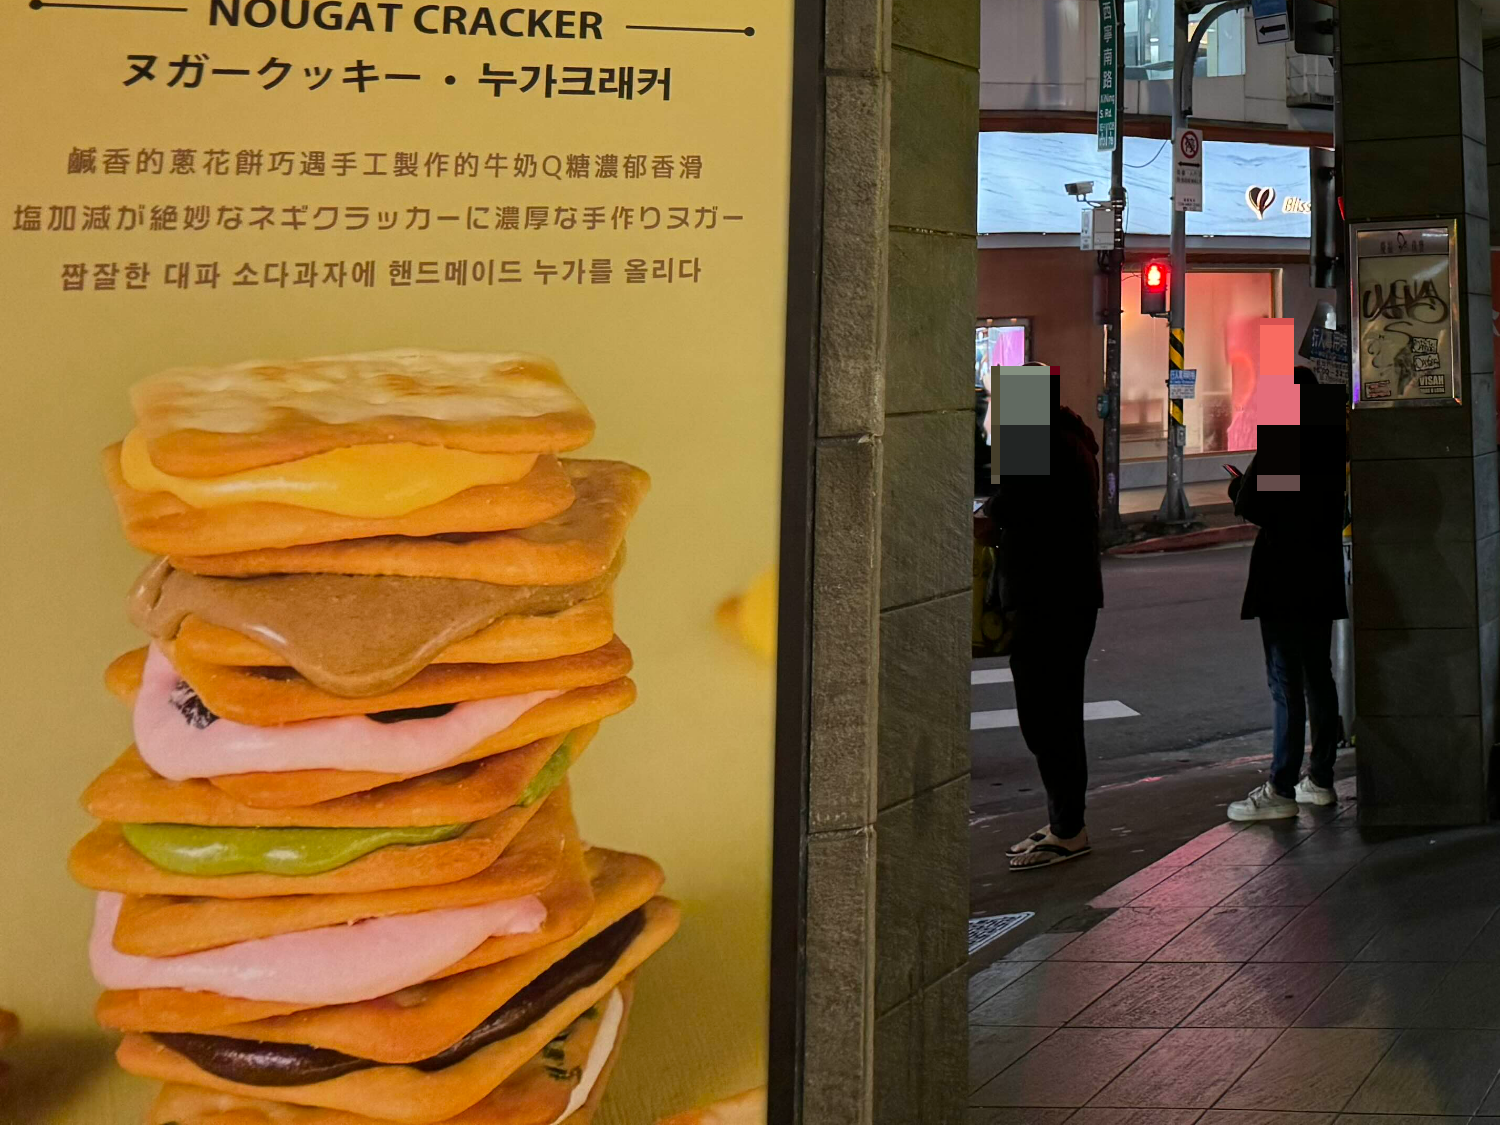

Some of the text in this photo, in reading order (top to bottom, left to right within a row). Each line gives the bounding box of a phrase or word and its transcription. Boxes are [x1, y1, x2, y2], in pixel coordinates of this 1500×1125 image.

[413, 4, 604, 41] CRACKER
[122, 53, 674, 102] ヌガークッキー 누가크래커
[164, 261, 220, 289] 대파
[232, 260, 376, 289] 소다과자에
[388, 259, 523, 287] 핸드메이드
[533, 258, 613, 285] 누가를
[624, 257, 702, 284] 올리다
